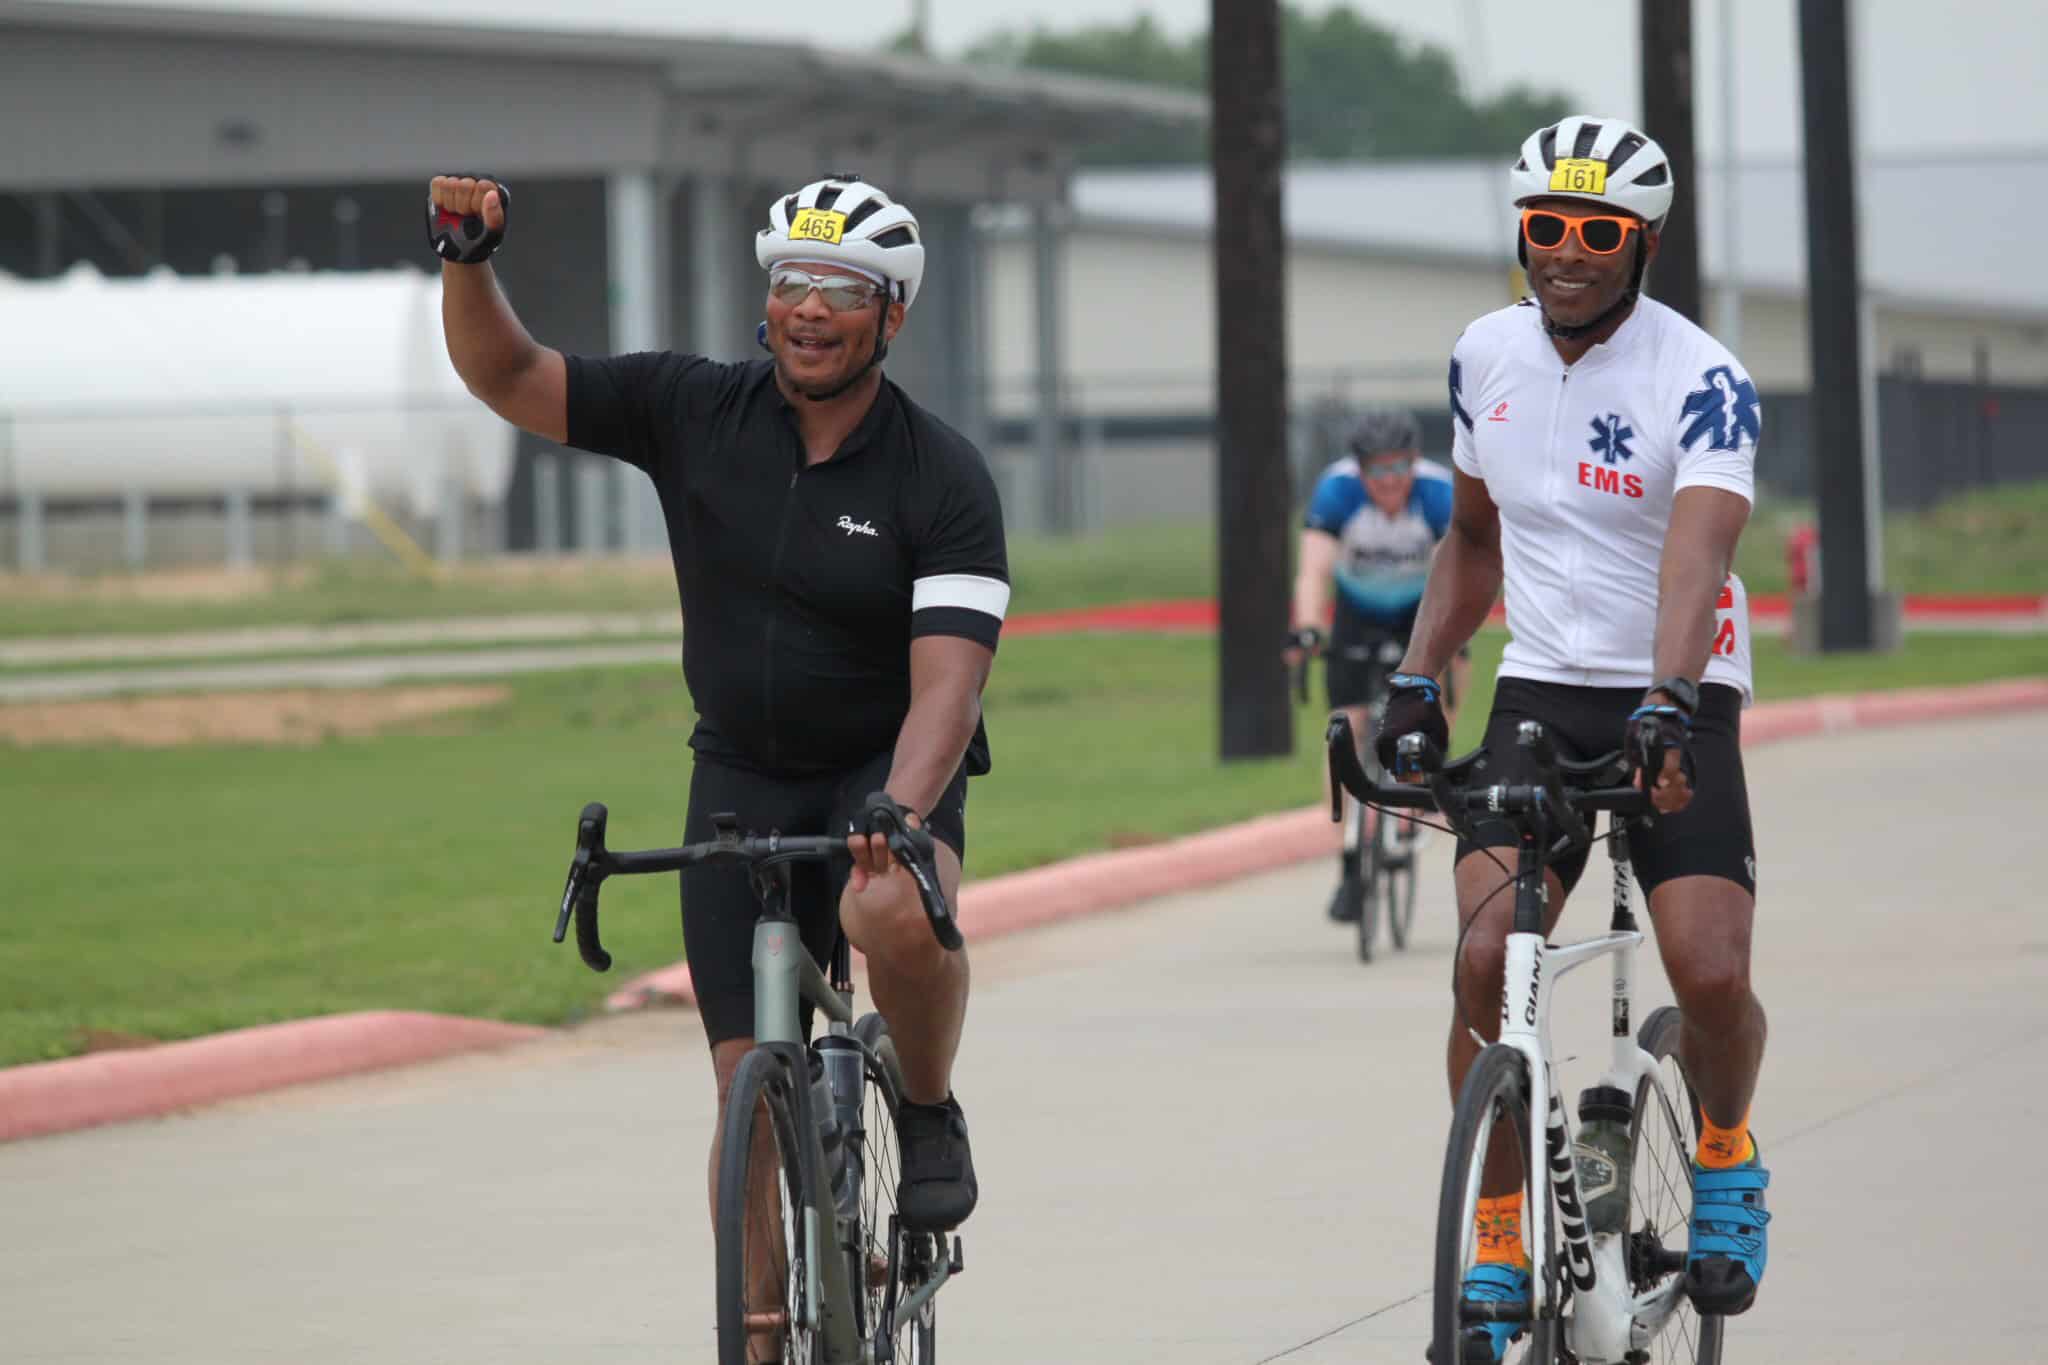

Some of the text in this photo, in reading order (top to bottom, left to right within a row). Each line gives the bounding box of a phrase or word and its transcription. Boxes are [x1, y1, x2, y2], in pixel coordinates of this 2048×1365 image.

[1564, 168, 1596, 190] 161
[800, 217, 836, 239] 465
[1578, 462, 1644, 499] EMS
[1525, 943, 1542, 1027] GIANT
